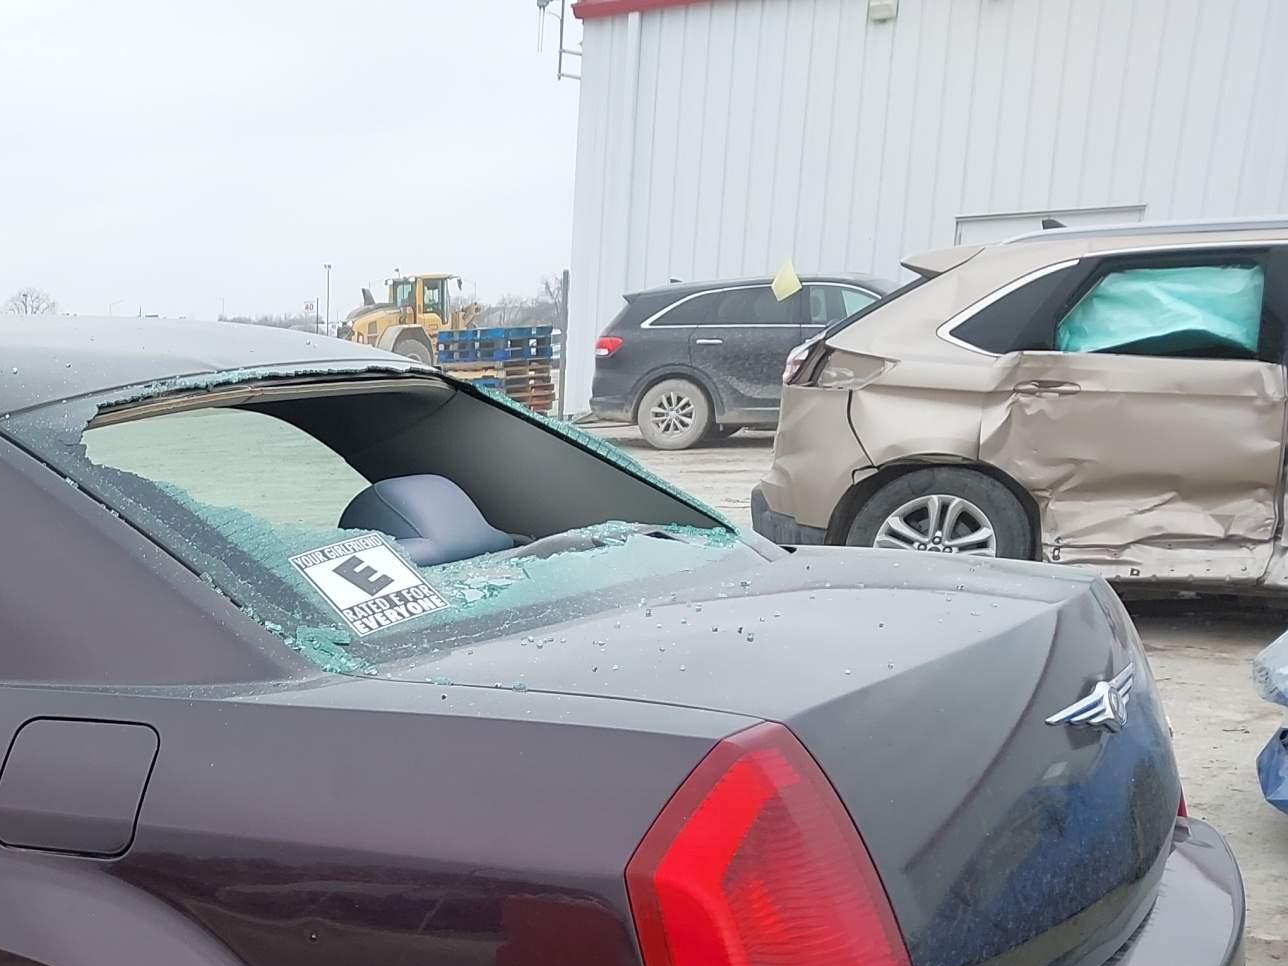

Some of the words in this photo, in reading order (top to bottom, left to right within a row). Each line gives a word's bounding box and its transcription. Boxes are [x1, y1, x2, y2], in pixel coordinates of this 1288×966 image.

[294, 550, 327, 569] YOUR
[324, 535, 384, 560] GIRLFRIEND
[332, 555, 395, 597] E
[343, 597, 390, 622] RATED
[389, 592, 404, 606] E
[402, 584, 434, 601] FOR
[352, 595, 446, 634] EVERYONE
